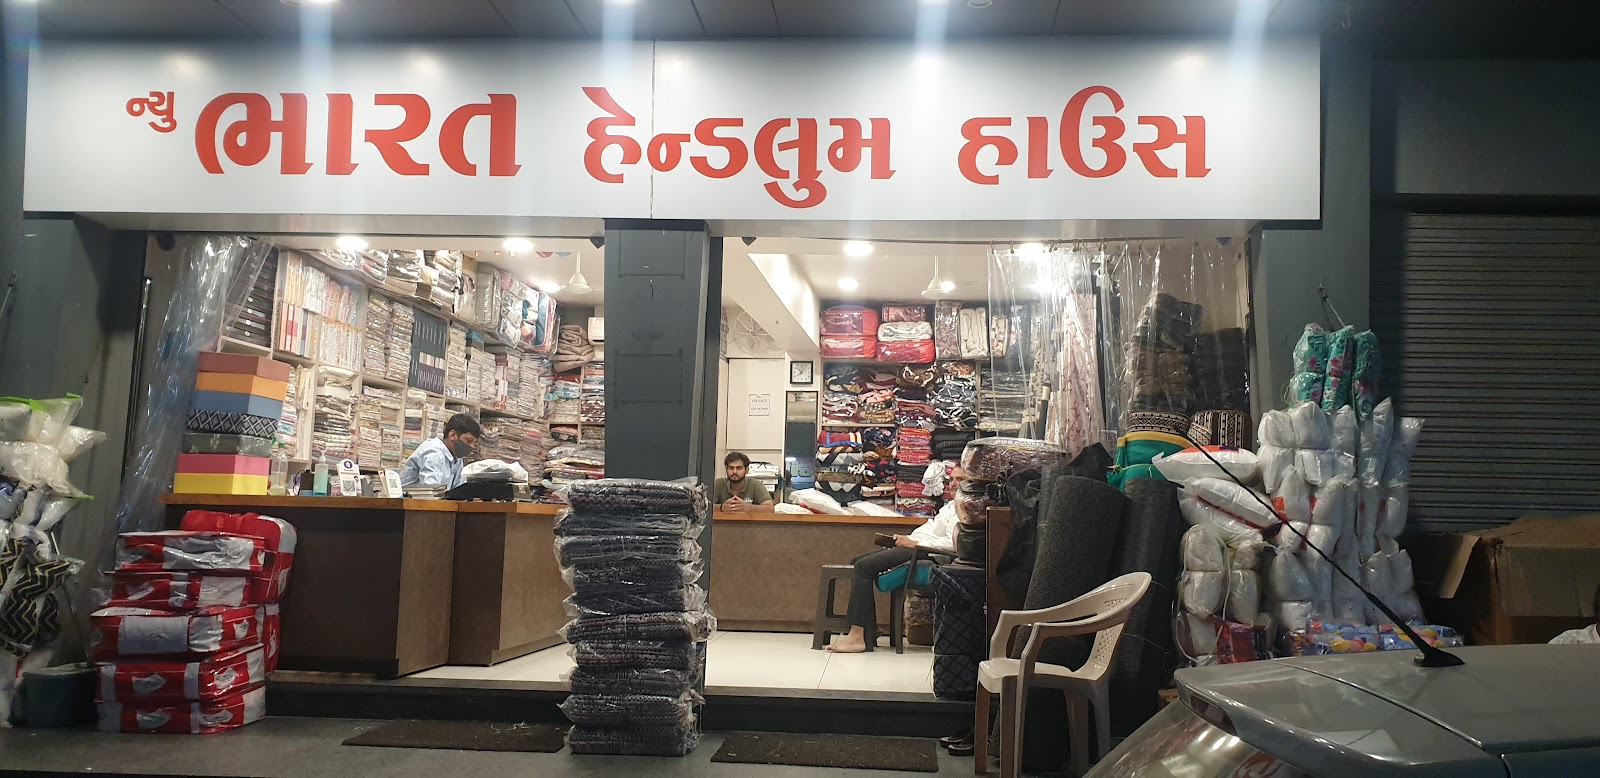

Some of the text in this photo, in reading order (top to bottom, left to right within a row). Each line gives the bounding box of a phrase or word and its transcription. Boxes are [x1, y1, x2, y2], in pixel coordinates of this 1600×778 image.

[126, 85, 1212, 208] ન્યુ ભારત હેન્ડલુમ હાઉસ
